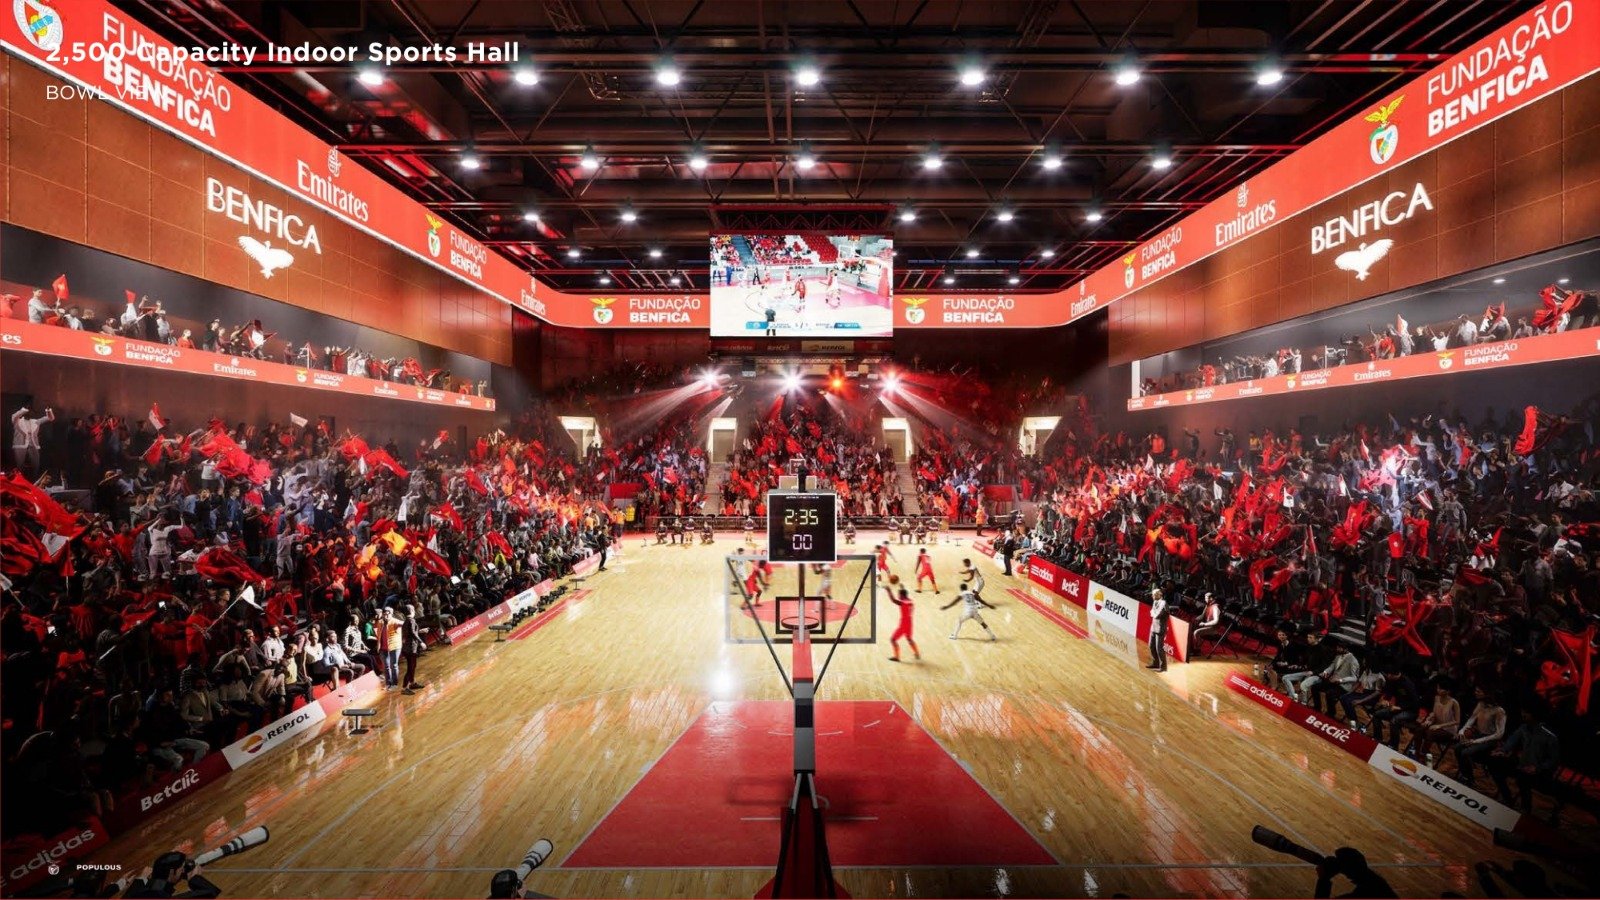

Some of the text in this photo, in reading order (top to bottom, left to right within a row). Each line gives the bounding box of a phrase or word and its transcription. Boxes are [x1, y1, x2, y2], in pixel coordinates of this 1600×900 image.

[1428, 0, 1572, 105] FUNDAÇÃO
[104, 52, 216, 137] BENFICA
[1428, 54, 1549, 137] BENFICA
[297, 159, 369, 222] Emirates
[206, 177, 321, 255] BENFICA
[1215, 199, 1276, 247] Emirates
[1311, 182, 1434, 255] BENFICA
[450, 230, 487, 262] FUNDAÇÃO
[1142, 227, 1182, 261] FUNDAÇÃO
[450, 250, 482, 280] BENFICA
[1142, 252, 1176, 280] BENFICA
[629, 296, 701, 312] FUNDAÇÃO
[943, 296, 1014, 312] FUNDAÇÃO
[1071, 294, 1096, 318] Emirates
[629, 312, 691, 323] BENFICA
[943, 312, 1004, 323] BENFICA
[125, 343, 181, 357] FUNDAÇÃO
[125, 351, 173, 364] BENFICA
[1464, 342, 1518, 357] FUNDAÇÃO
[1464, 353, 1509, 366] BENFICA
[214, 363, 257, 377] Emirates
[1354, 368, 1391, 381] Emirates
[785, 509, 818, 525] 2:35
[792, 534, 813, 550] 00
[1105, 599, 1129, 620] REPSOL
[1250, 685, 1489, 816] adidas BetClic REPSOL
[10, 713, 310, 880] adidas BetClic REPSOL
